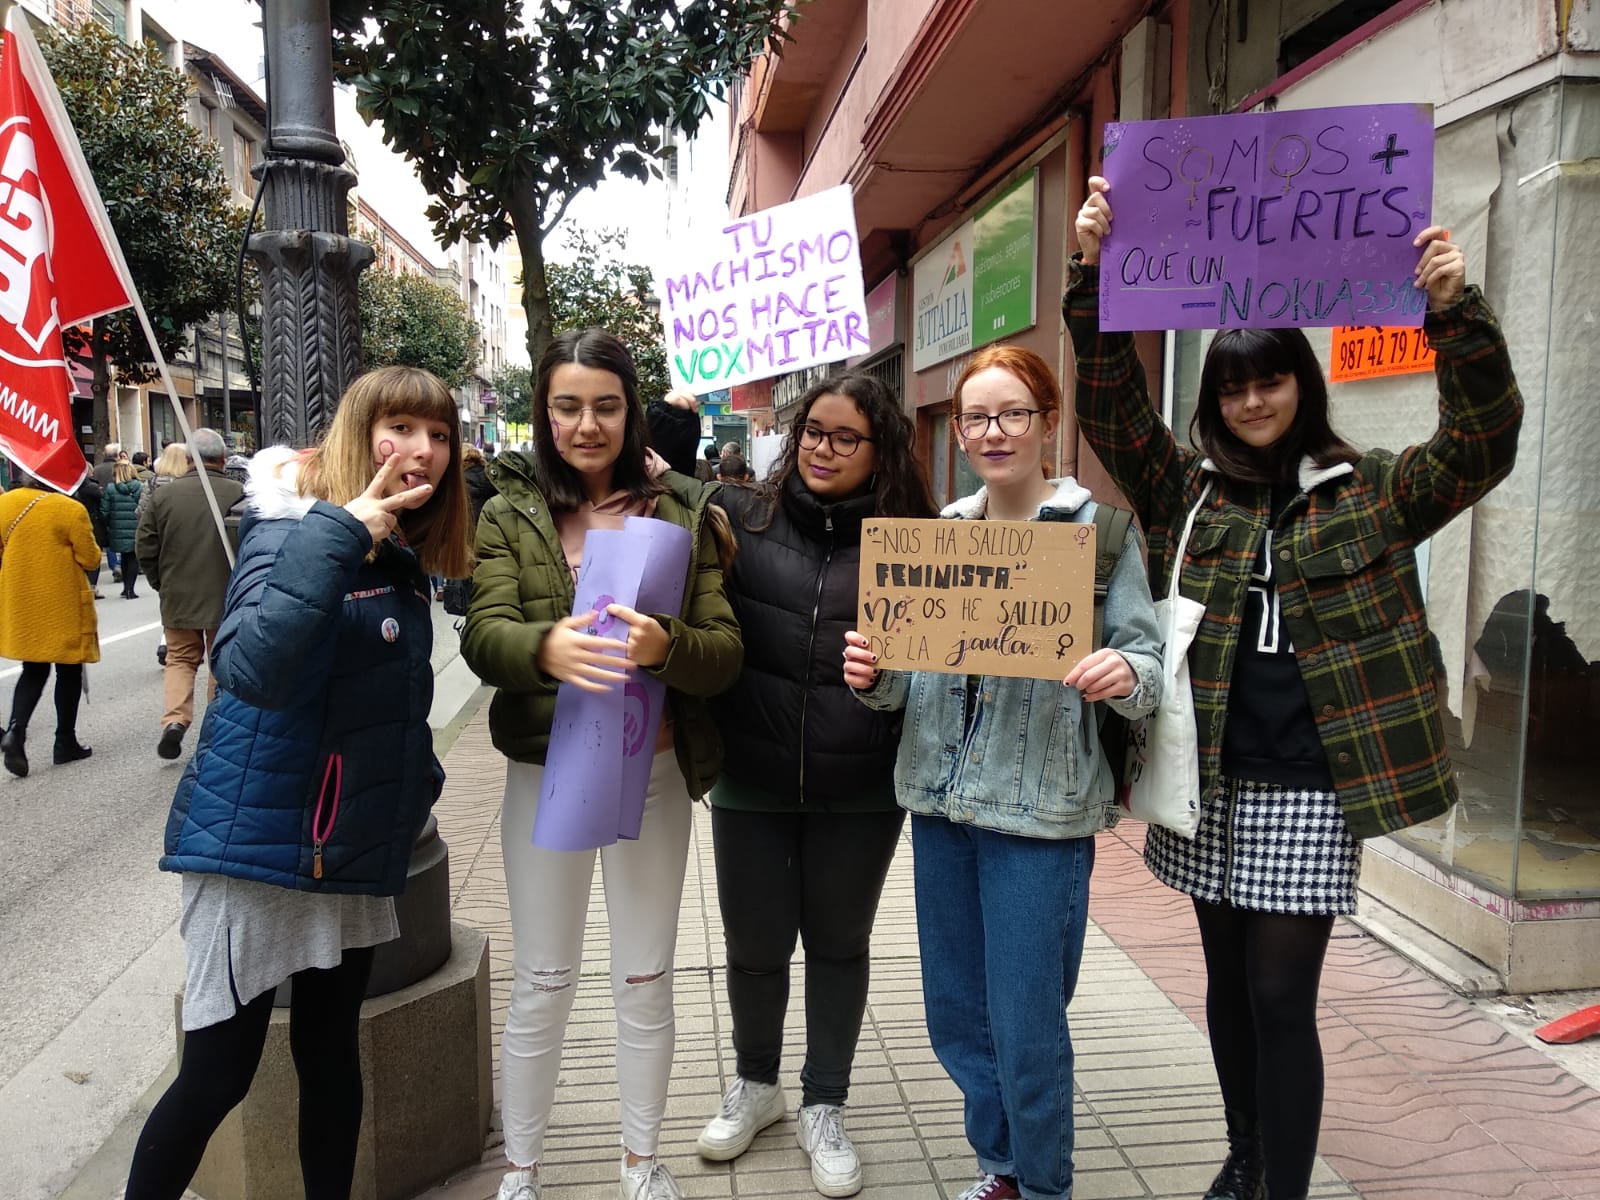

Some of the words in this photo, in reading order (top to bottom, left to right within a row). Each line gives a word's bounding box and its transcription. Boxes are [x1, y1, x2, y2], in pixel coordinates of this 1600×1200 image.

[1143, 125, 1350, 205] SOMOS
[722, 214, 772, 253] TU
[1207, 186, 1412, 246] FUERTES
[666, 230, 852, 311] MACHISMO
[1120, 247, 1179, 286] QUE
[1189, 255, 1225, 285] UN
[673, 302, 739, 348] NOS
[750, 274, 848, 329] HACE
[674, 311, 870, 384] VOXMITAR
[1340, 340, 1364, 371] 987
[1367, 334, 1385, 367] 42
[1390, 330, 1408, 364] 79
[934, 527, 957, 556] HA
[968, 525, 1034, 556] SALIDO
[922, 597, 946, 619] OS
[961, 597, 982, 622] HE
[996, 599, 1072, 627] SALIDO
[868, 635, 895, 661] DE
[906, 635, 931, 661] LA
